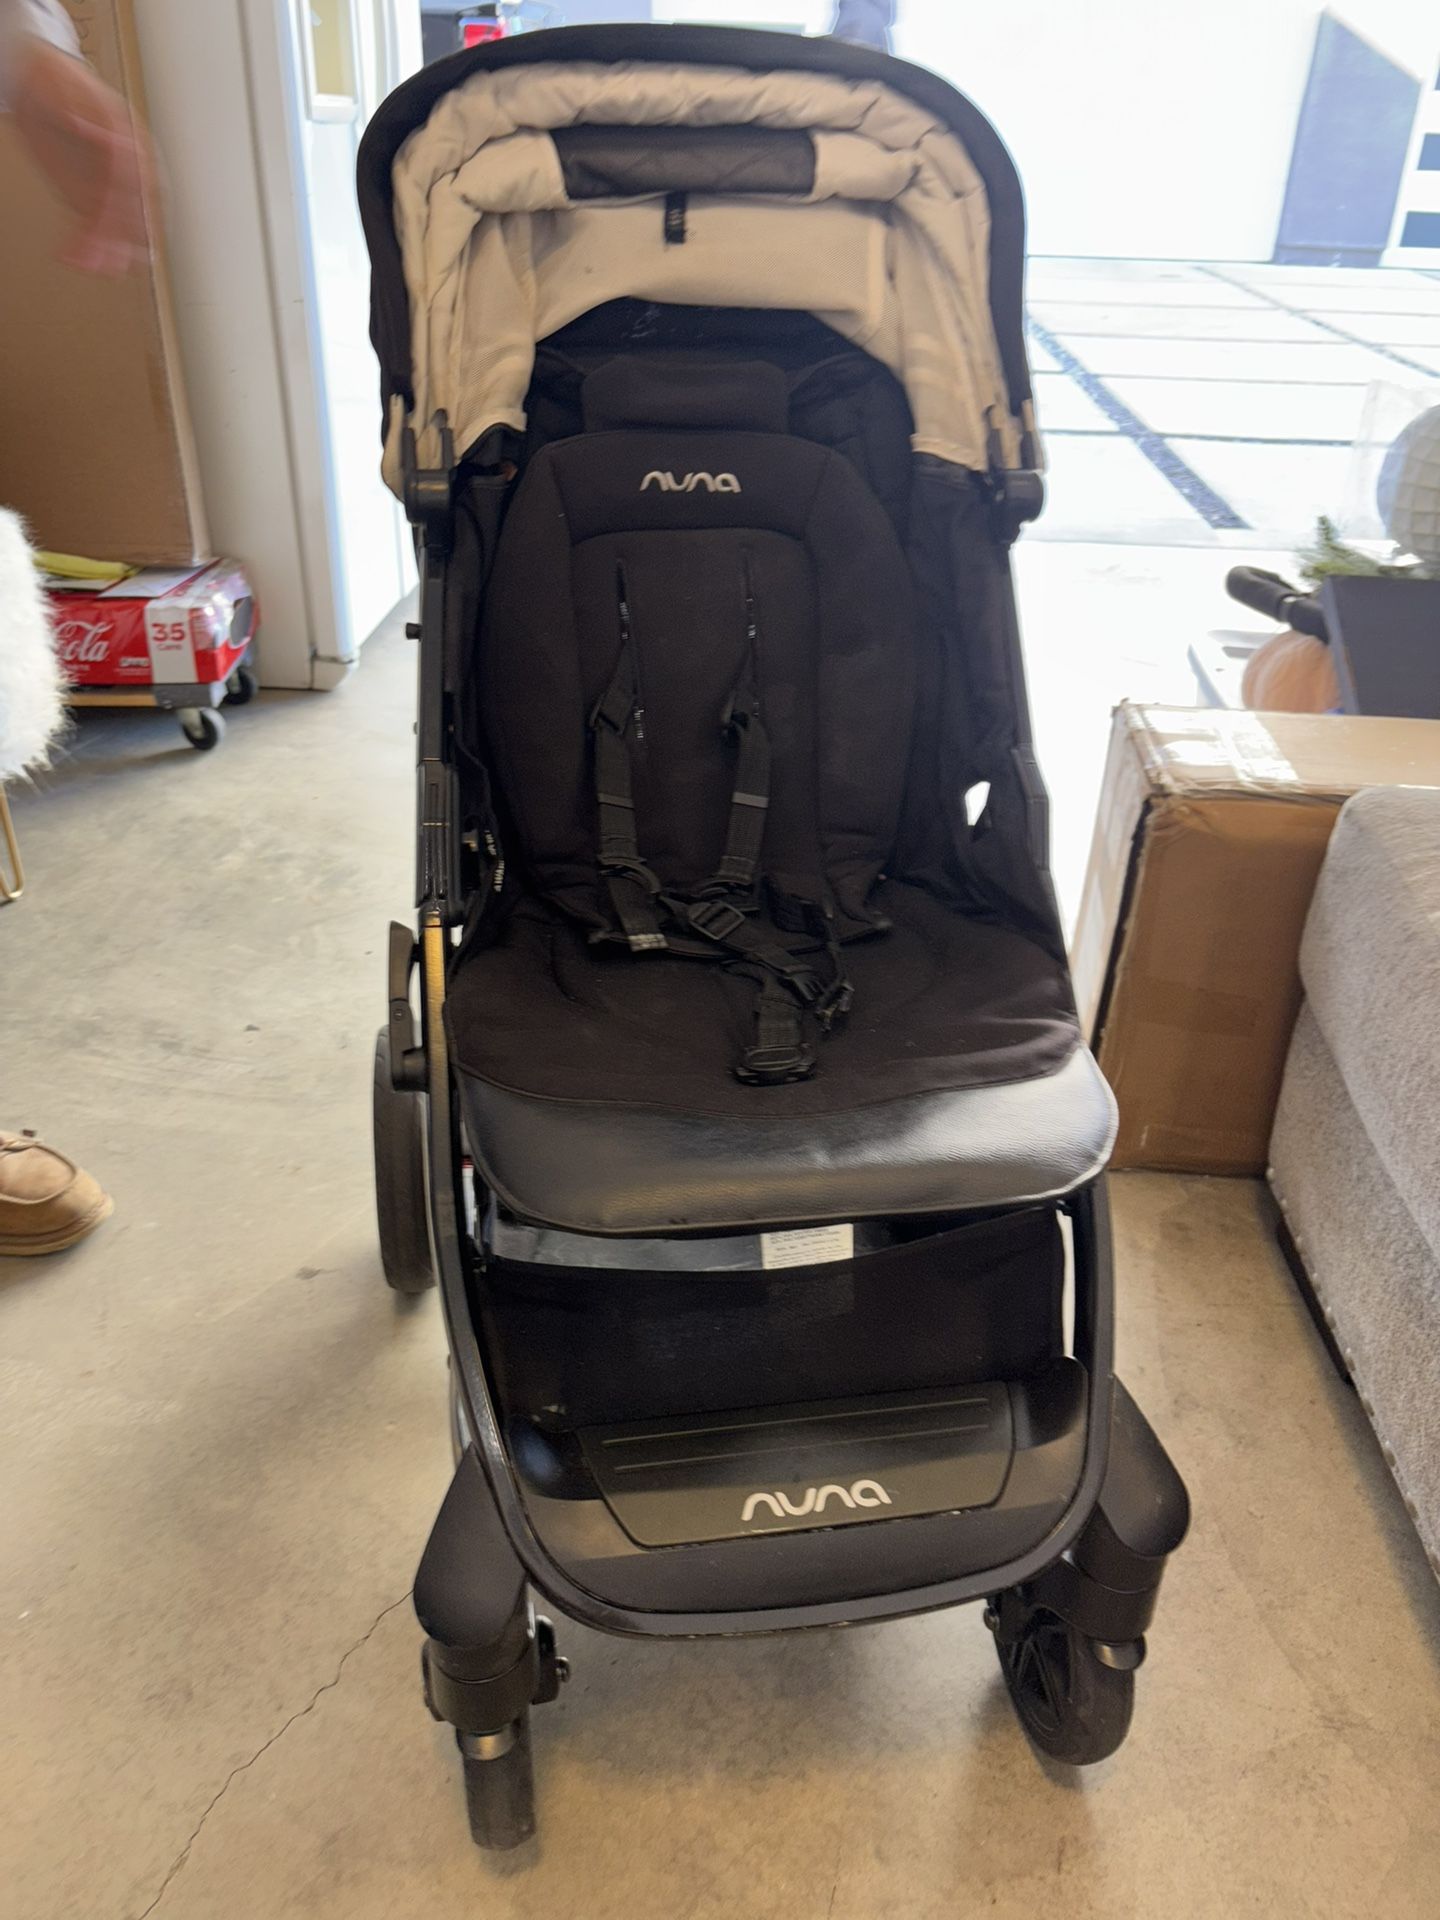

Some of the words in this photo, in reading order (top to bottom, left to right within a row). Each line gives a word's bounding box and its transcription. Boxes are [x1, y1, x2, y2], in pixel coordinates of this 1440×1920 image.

[640, 470, 742, 493] nuna
[152, 622, 185, 641] 35
[741, 1479, 892, 1521] nuna
